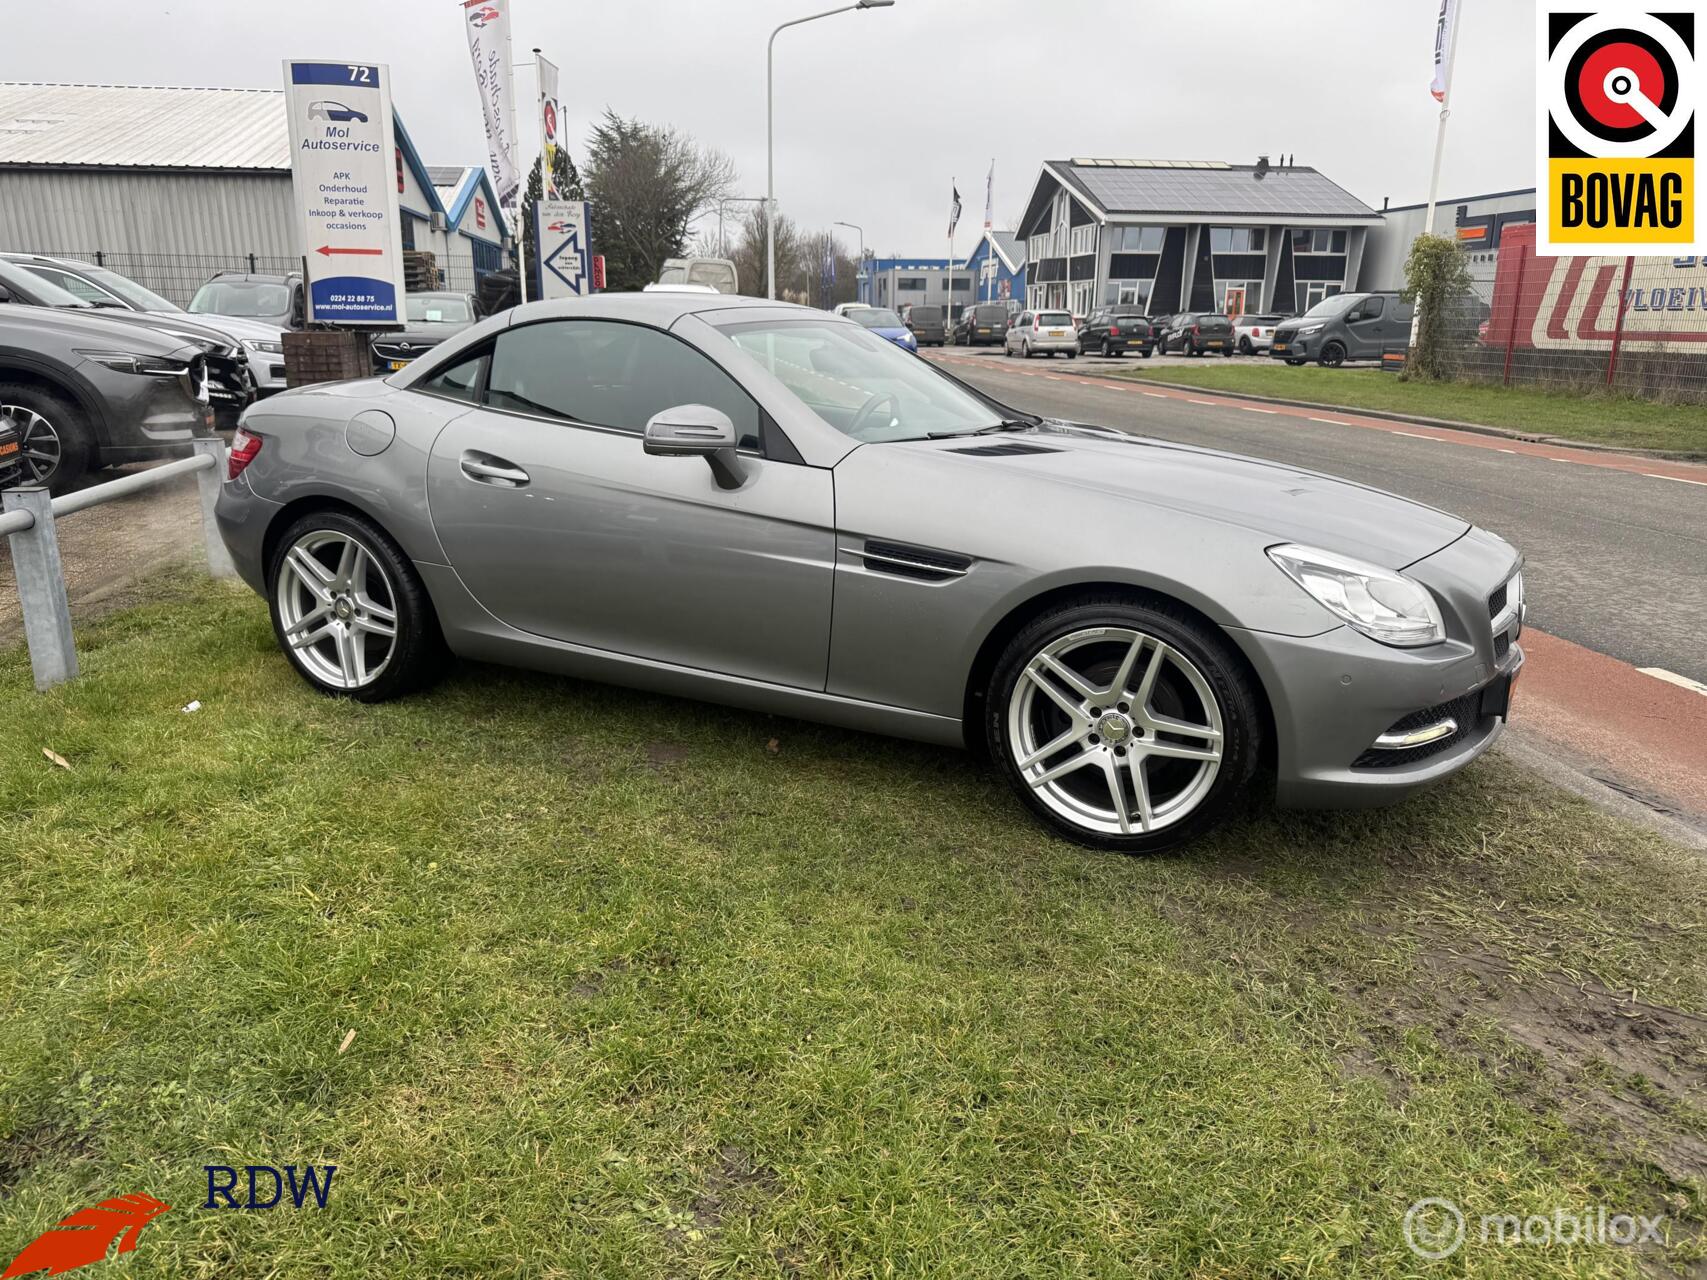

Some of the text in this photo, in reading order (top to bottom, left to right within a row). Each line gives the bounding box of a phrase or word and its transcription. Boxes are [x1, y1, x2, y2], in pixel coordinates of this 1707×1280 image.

[347, 66, 371, 82] 72
[325, 126, 350, 138] Mol
[301, 138, 380, 153] Autoservice
[333, 172, 351, 180] APK
[319, 184, 368, 193] Onderhoud
[324, 197, 365, 206] Reparatie
[308, 209, 383, 219] Inkoop & verkoop
[326, 221, 367, 230] occasions
[315, 303, 393, 311] www.mol-autoservice.nl
